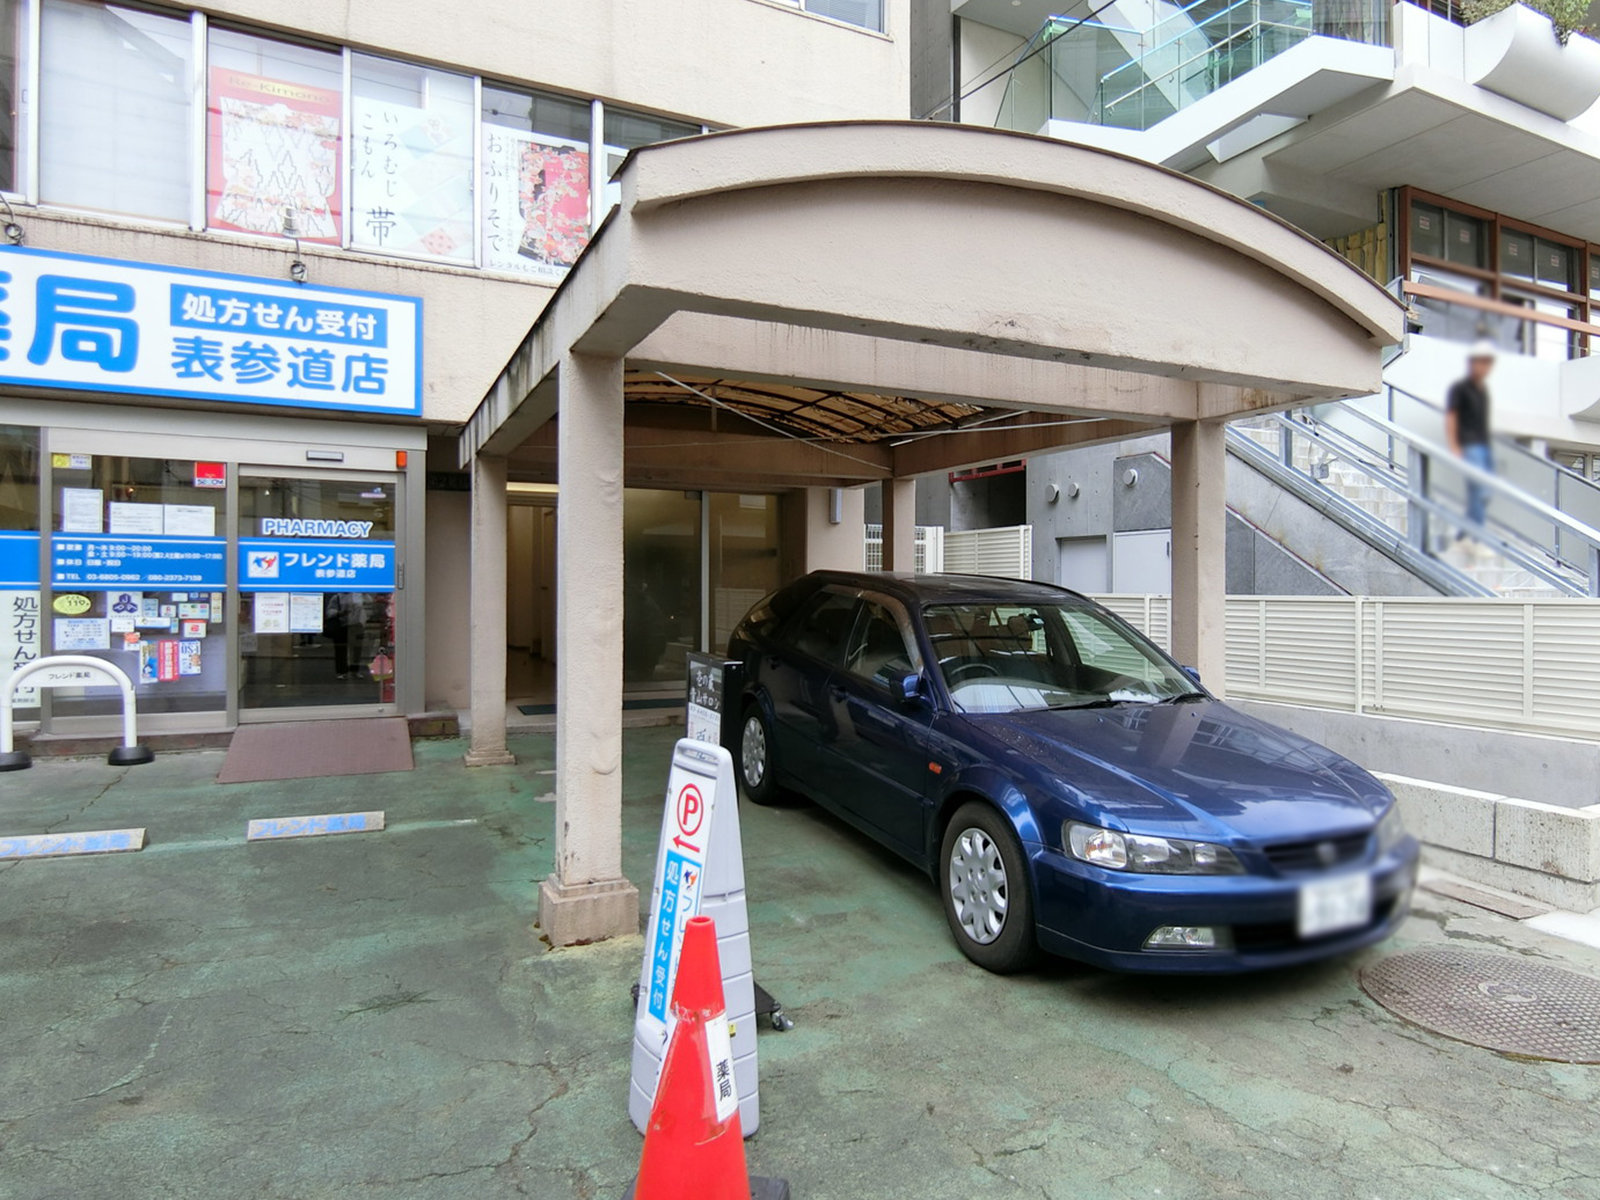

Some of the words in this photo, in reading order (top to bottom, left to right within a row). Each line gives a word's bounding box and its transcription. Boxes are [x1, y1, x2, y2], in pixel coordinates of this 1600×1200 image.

[360, 113, 375, 179] こもん
[383, 111, 399, 198] いろむじ
[485, 132, 503, 252] おふりそで
[366, 206, 397, 247] 帯
[0, 270, 140, 372] 局
[182, 292, 378, 341] 処方せん受付
[171, 335, 389, 396] 表参道店
[263, 519, 373, 537] PHARMACY
[283, 553, 386, 569] フレンド薬局
[653, 859, 680, 1010] 処方せん受付
[716, 1058, 732, 1102] 薬局
